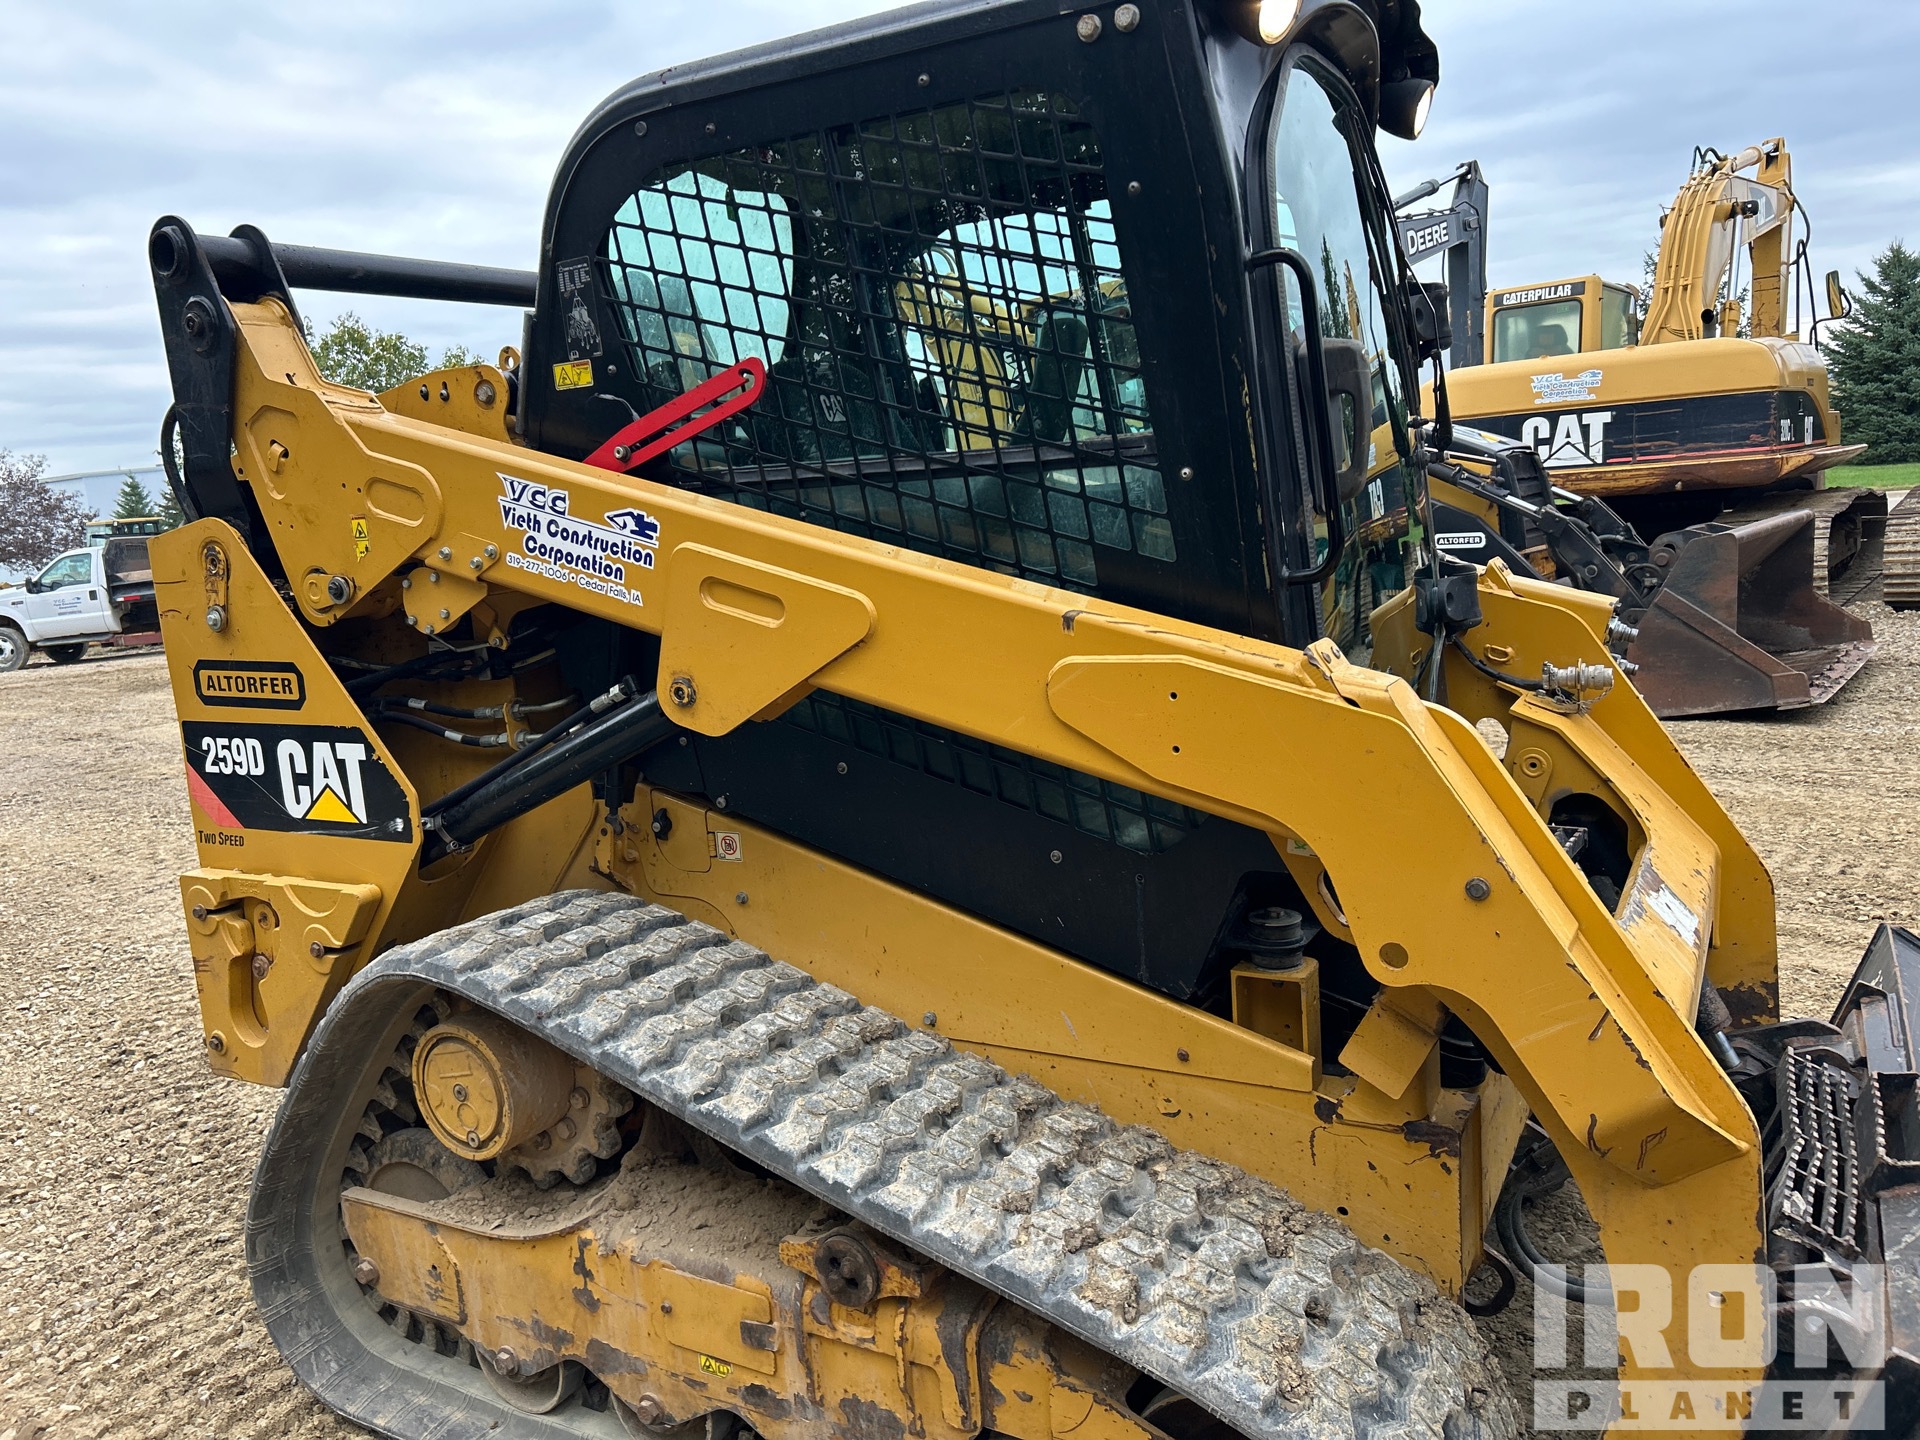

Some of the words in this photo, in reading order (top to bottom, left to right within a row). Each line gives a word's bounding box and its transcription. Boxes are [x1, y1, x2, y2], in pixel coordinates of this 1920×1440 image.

[1406, 222, 1449, 256] DEERE
[1503, 284, 1572, 305] CATERPILLAR
[1543, 388, 1587, 397] Corporation
[1552, 380, 1600, 389] Construction
[1522, 411, 1612, 464] CAT
[502, 476, 567, 516] VCC
[502, 505, 541, 533] Vieth
[547, 519, 653, 567] Construction
[1438, 537, 1480, 545] ALTORFER
[525, 535, 623, 581] Corporation
[507, 554, 568, 581] 319-277-1006
[578, 575, 606, 592] Cedar
[609, 586, 629, 600] Falls,
[632, 592, 641, 604] IA
[206, 675, 294, 695] ALTORFER
[201, 736, 265, 776] 259D
[277, 738, 368, 825] CAT
